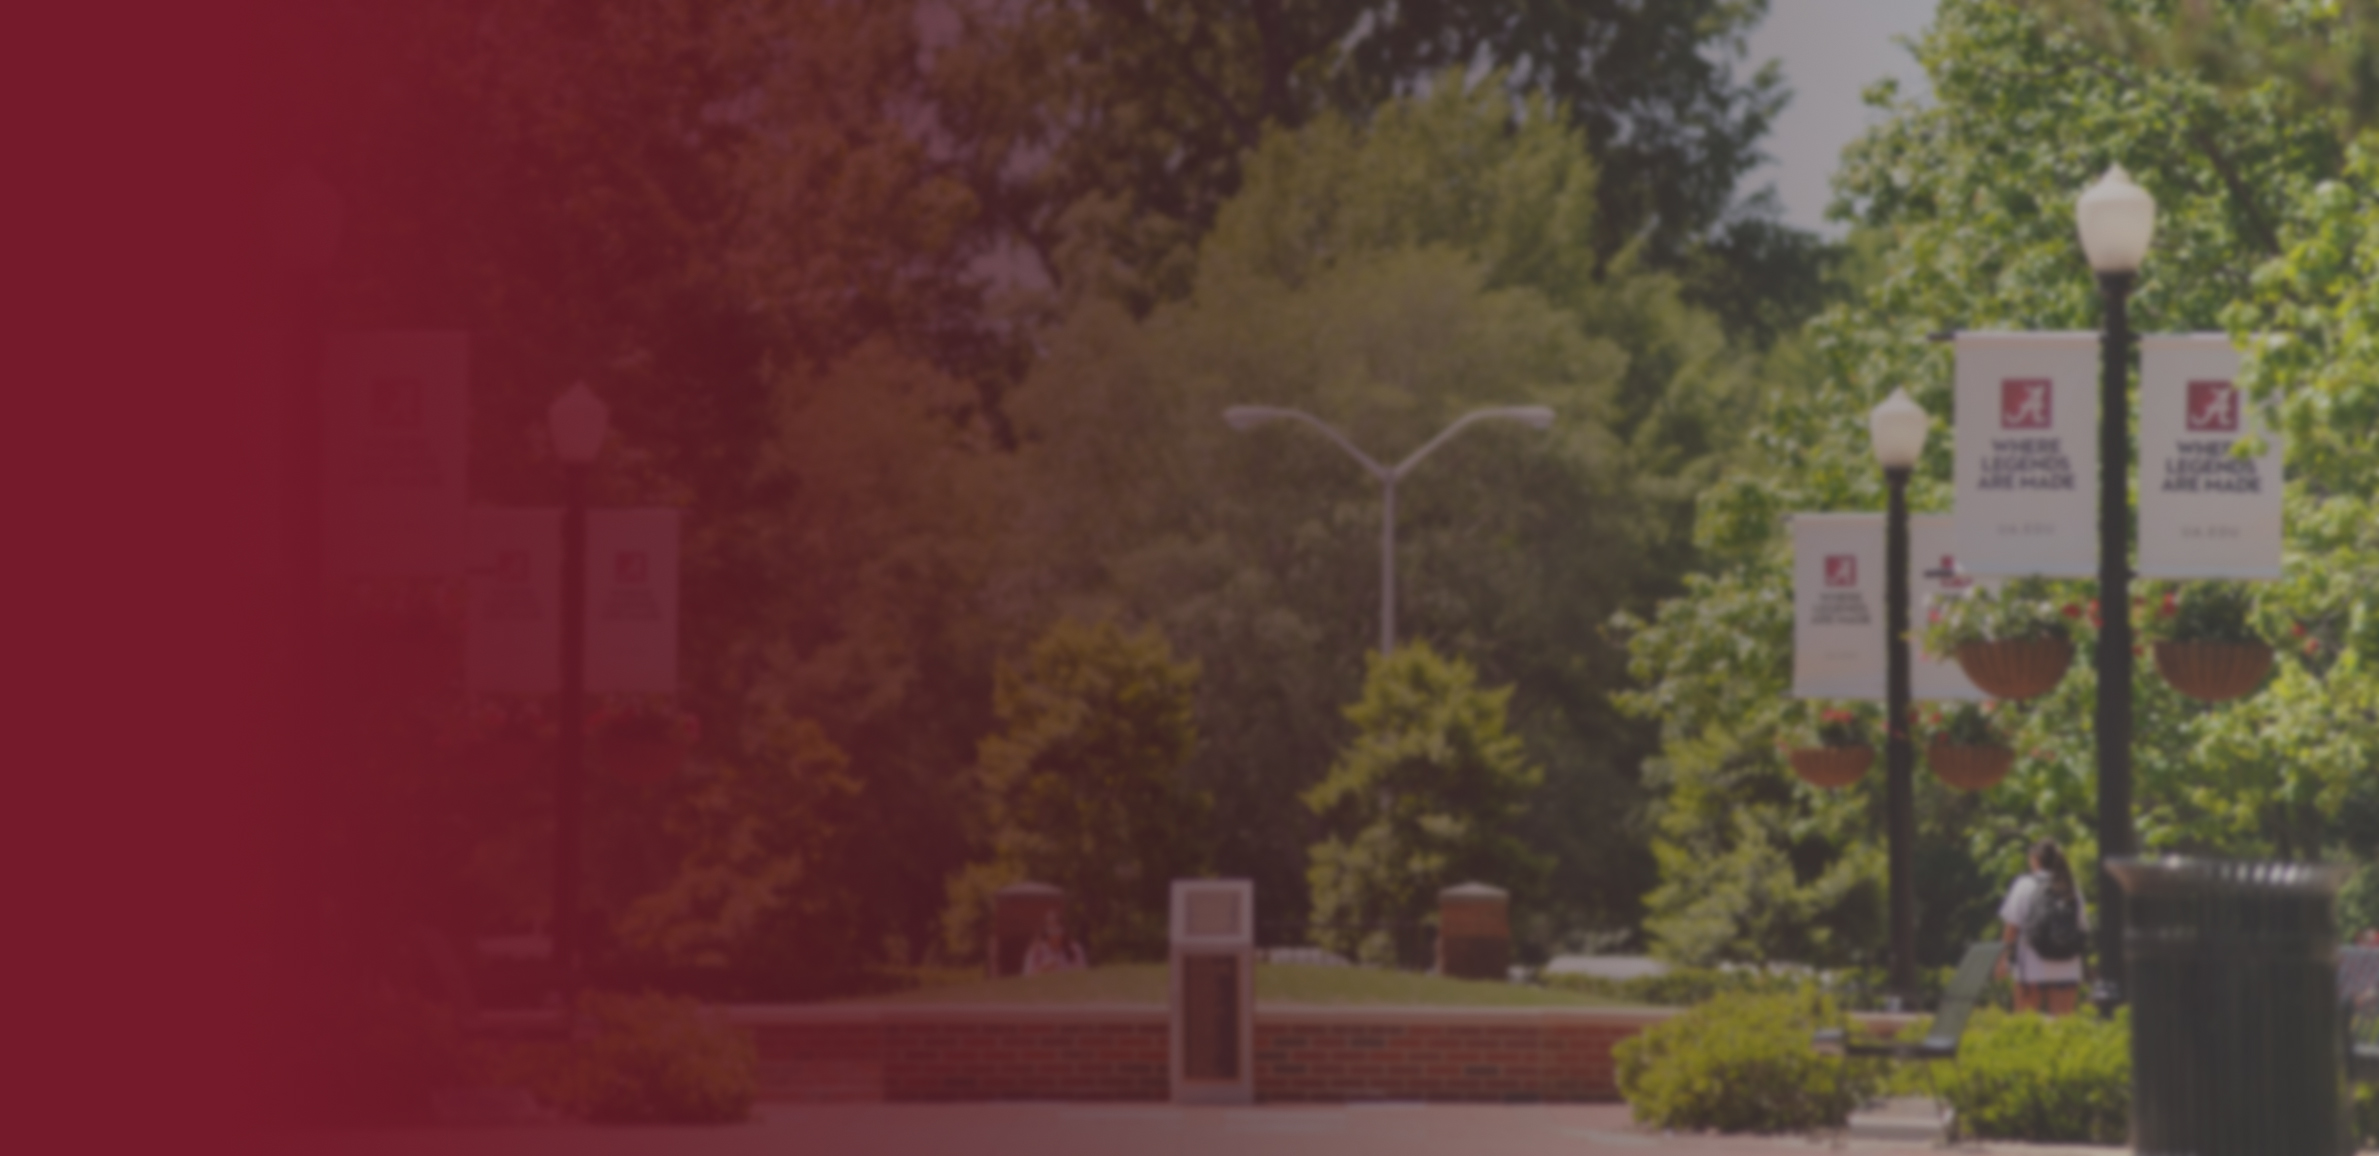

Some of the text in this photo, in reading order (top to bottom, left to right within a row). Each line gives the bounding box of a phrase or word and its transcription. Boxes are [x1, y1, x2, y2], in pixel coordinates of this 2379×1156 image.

[1990, 439, 2061, 454] WHERE
[1980, 456, 2071, 472] LEGENDS
[2164, 458, 2257, 474] LEGENDS
[1977, 474, 2076, 490] ARE MADE
[2161, 476, 2261, 492] ARE MADE
